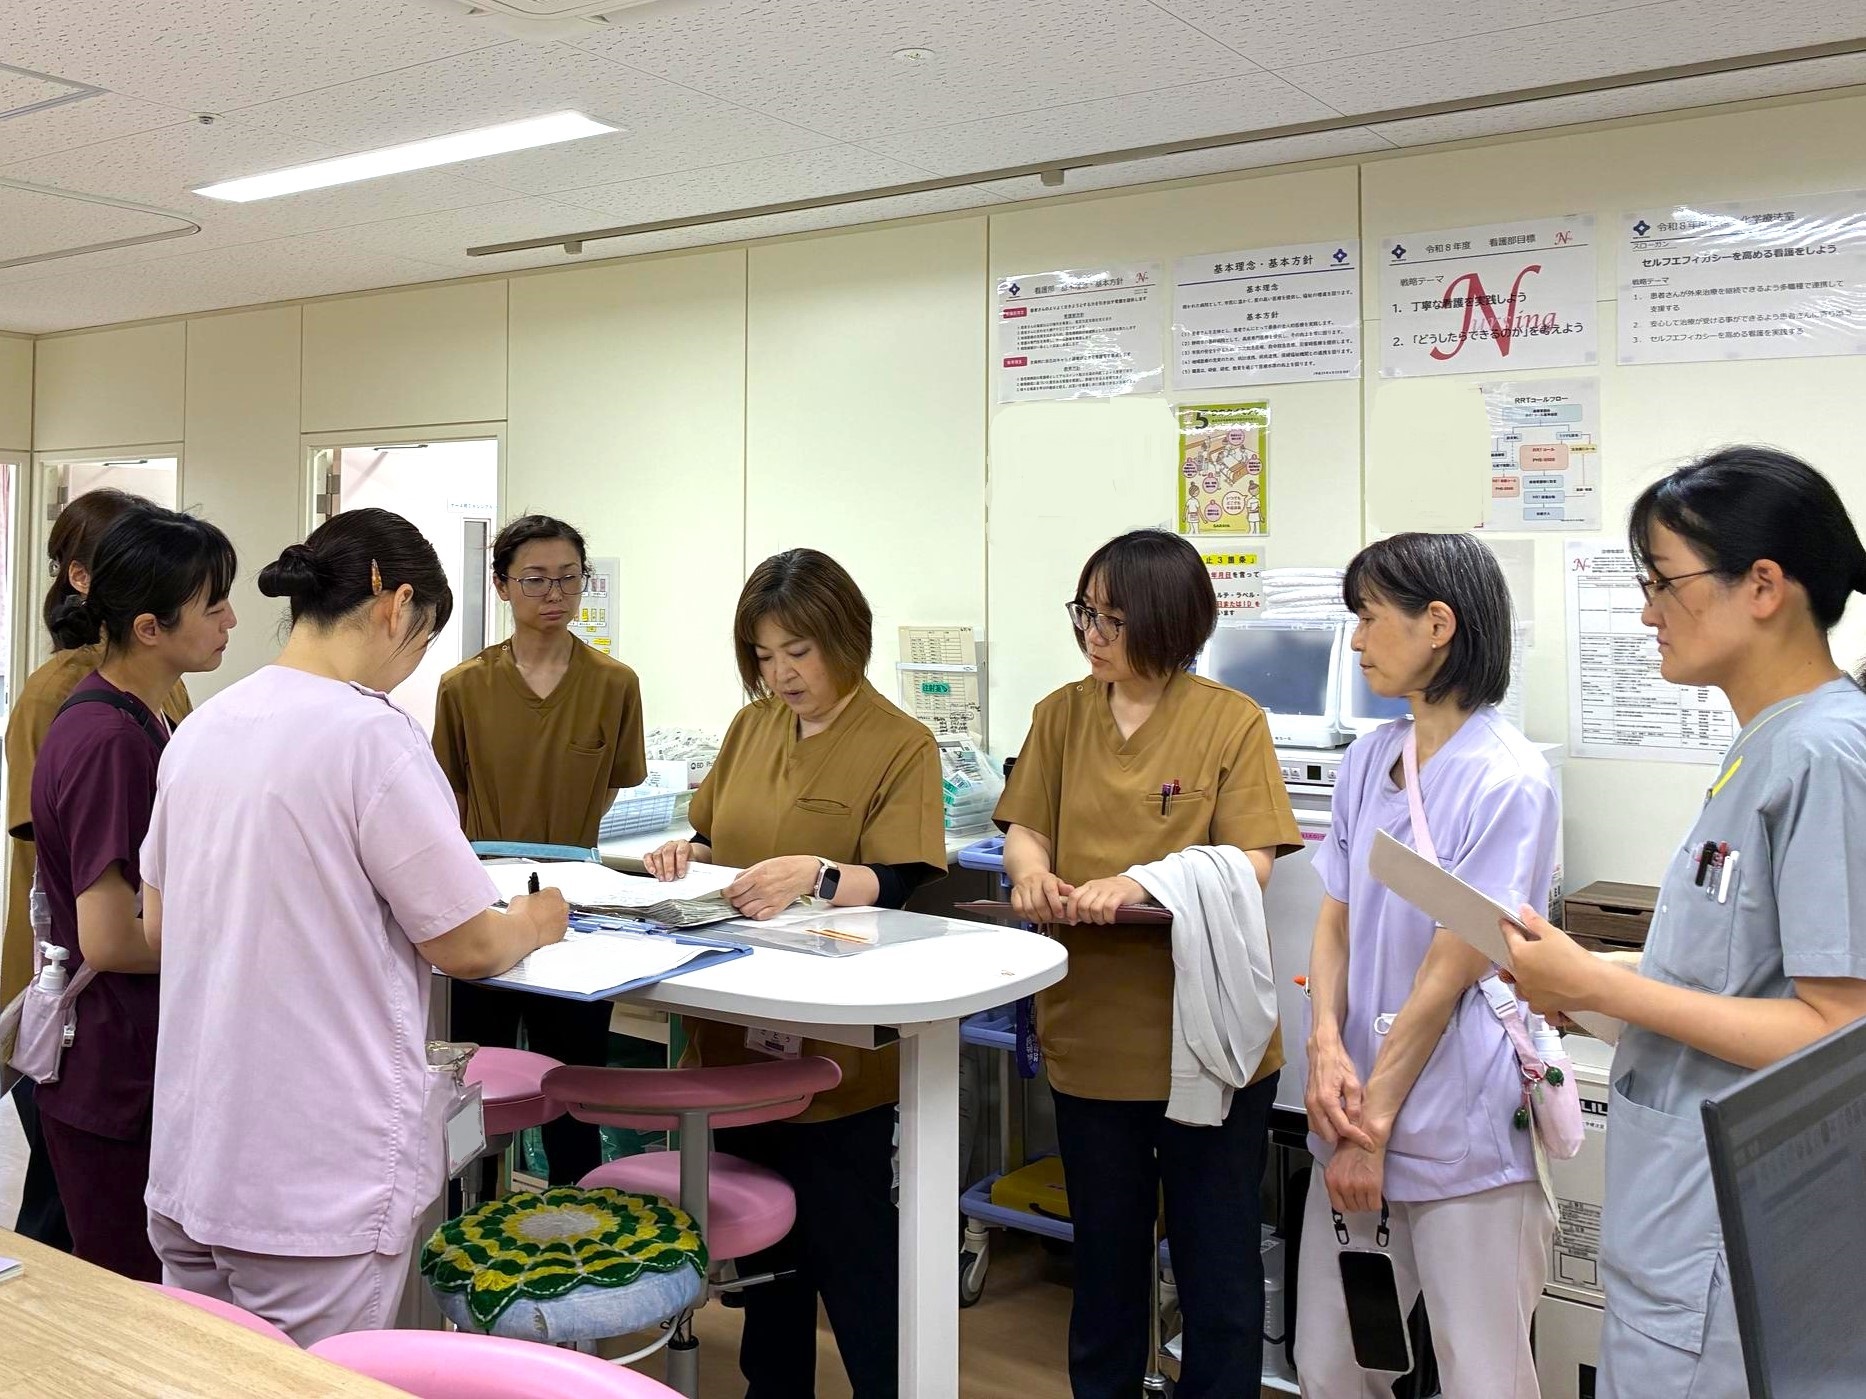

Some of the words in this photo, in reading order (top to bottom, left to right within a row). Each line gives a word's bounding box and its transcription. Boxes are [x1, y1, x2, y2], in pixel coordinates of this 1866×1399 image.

[1426, 241, 1471, 254] 令和8年度
[1489, 234, 1536, 247] 看護部目標
[1213, 255, 1314, 275] 基本理念・基本方針
[1400, 275, 1445, 287] 戦略テーマ
[1632, 277, 1669, 286] 戦略テーマ
[1246, 283, 1279, 294] 基本理念
[1392, 304, 1402, 313] 1.
[1411, 292, 1527, 312] 丁寧な看護を実践しよう
[1246, 311, 1279, 321] 基本方針
[1393, 337, 1404, 346] 2.
[1413, 322, 1584, 345] 「どうしたらできるのか」を考えよう
[1514, 395, 1569, 404] RRTコールフロー
[1209, 571, 1260, 579] 年月日を言って
